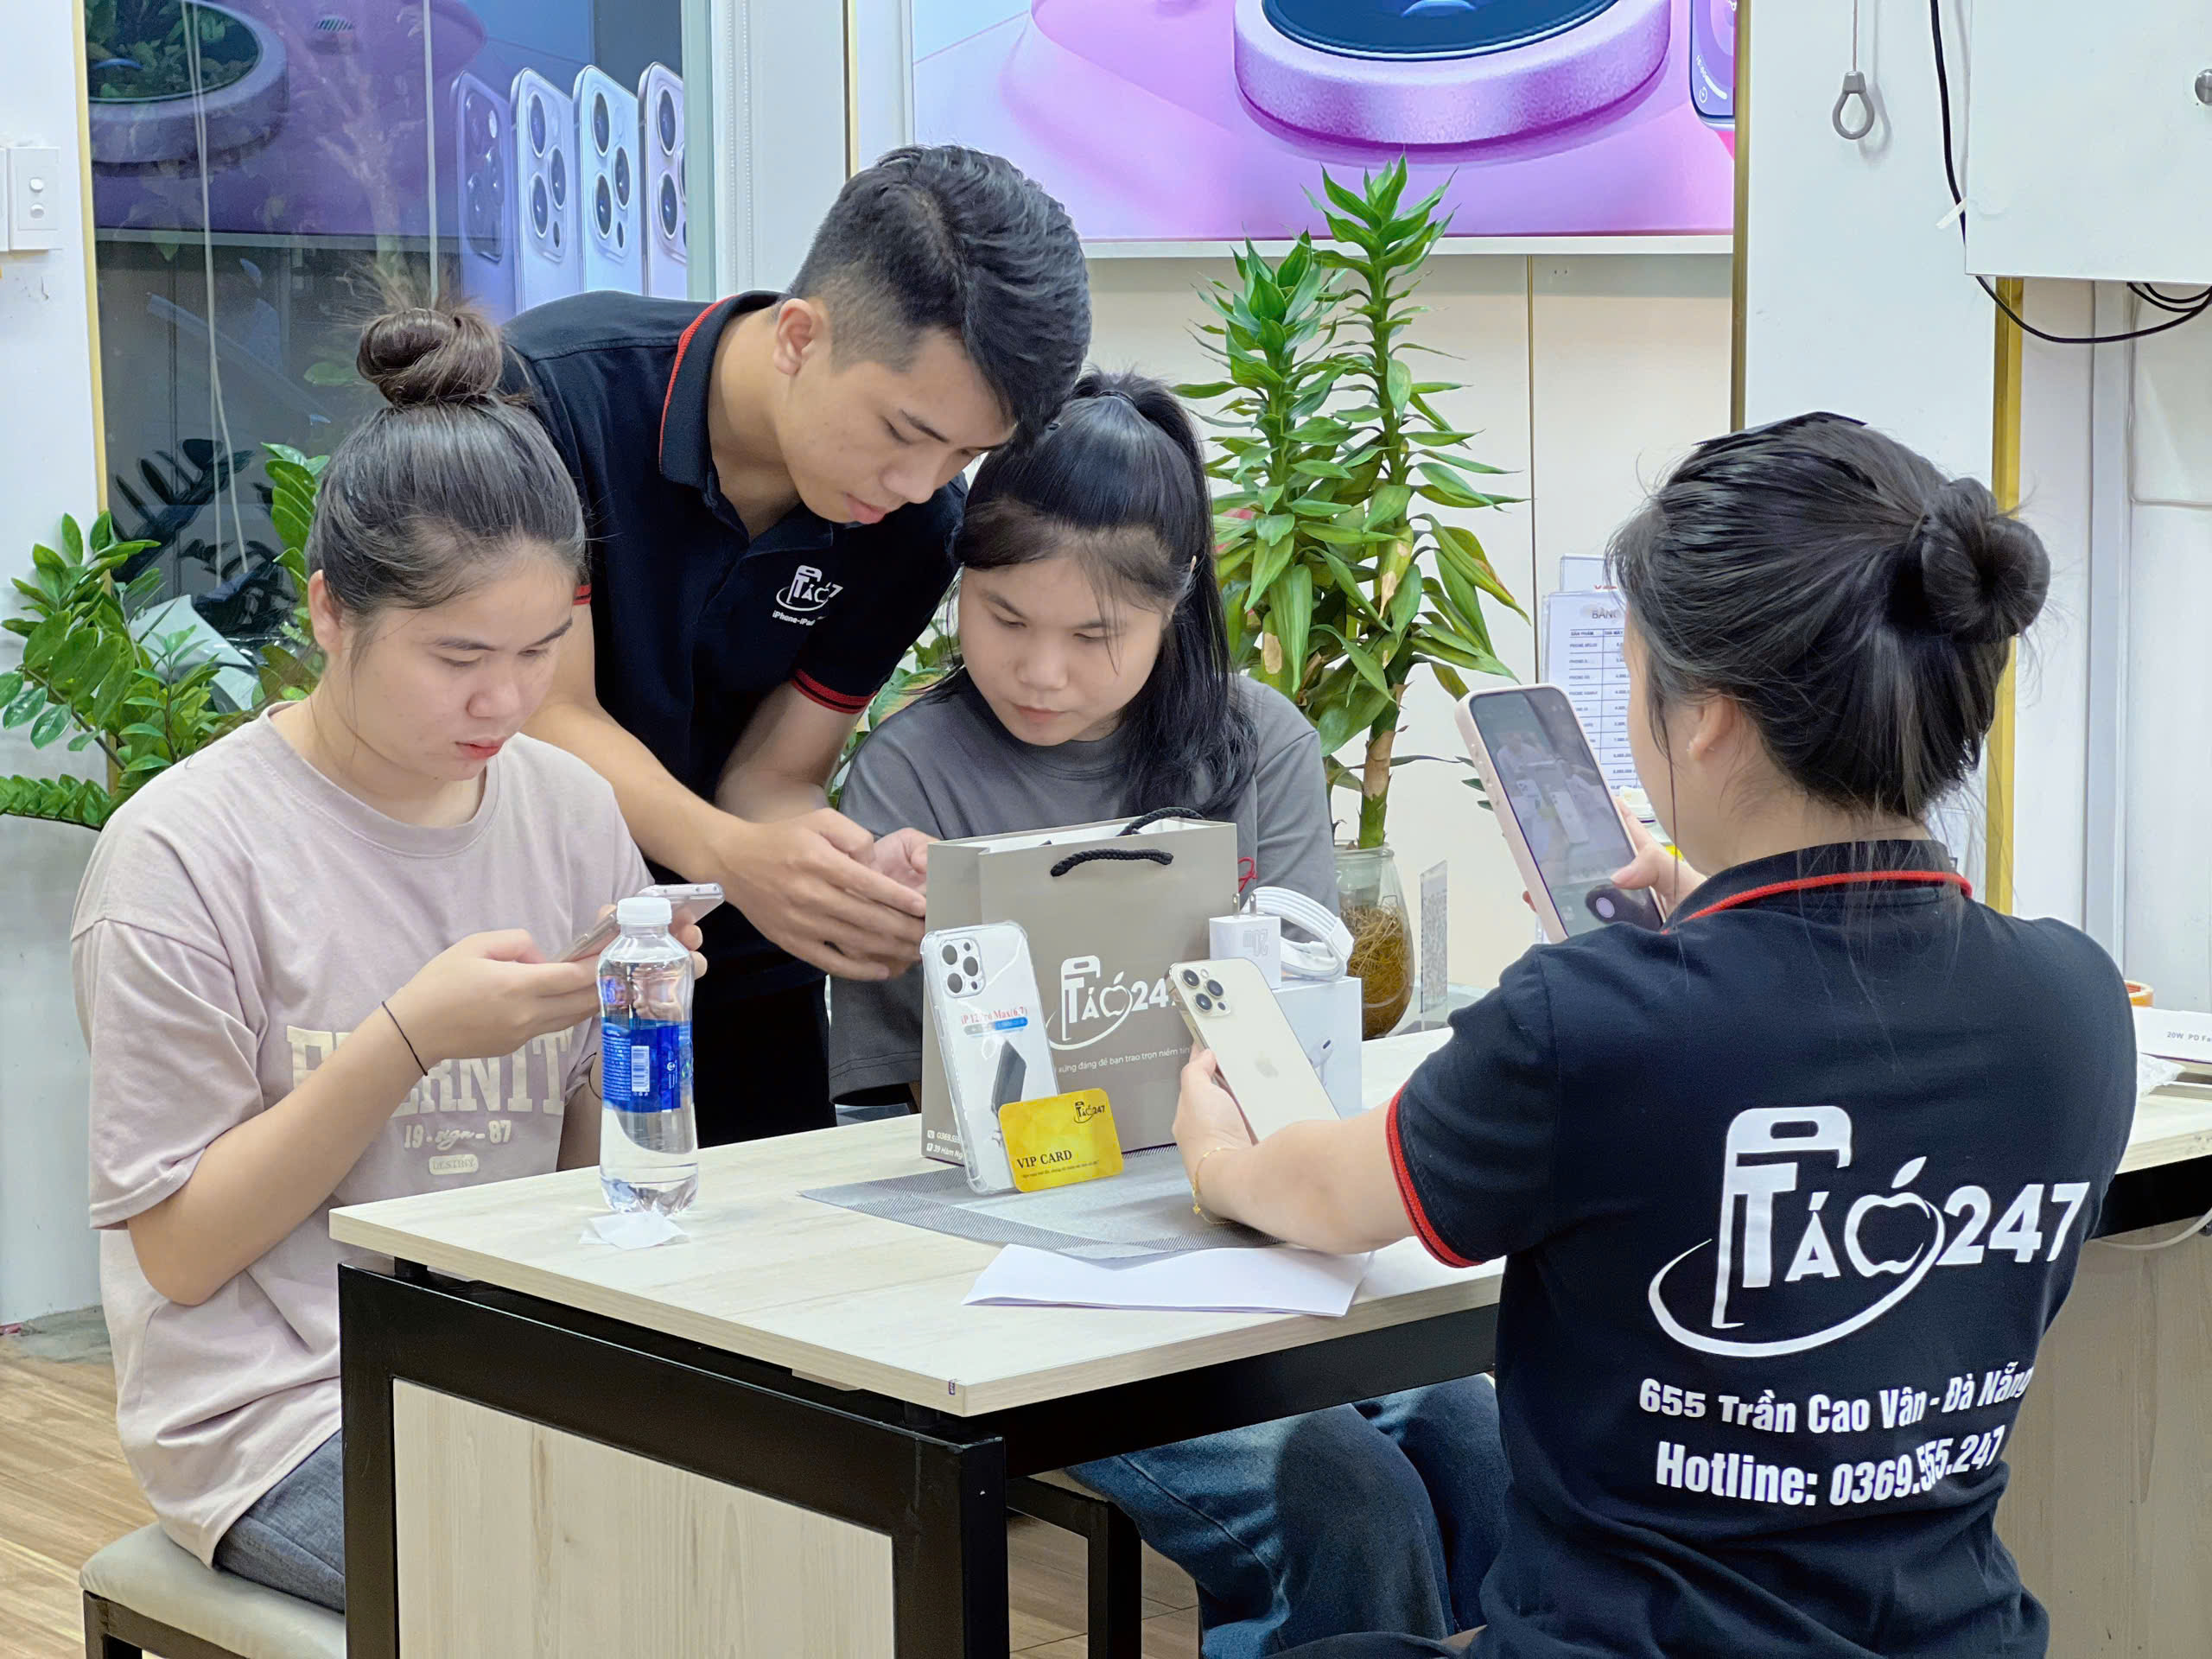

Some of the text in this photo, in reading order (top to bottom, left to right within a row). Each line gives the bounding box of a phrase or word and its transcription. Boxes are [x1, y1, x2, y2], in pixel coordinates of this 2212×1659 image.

[1016, 1155, 1037, 1169] VIP
[1039, 1149, 1072, 1165] CARD
[1638, 1377, 1707, 1418] 655
[1718, 1389, 1797, 1433] Trần
[1808, 1394, 1871, 1433] Cao
[1941, 1372, 1975, 1414] Đà
[1656, 1440, 1819, 1506] Hotline:
